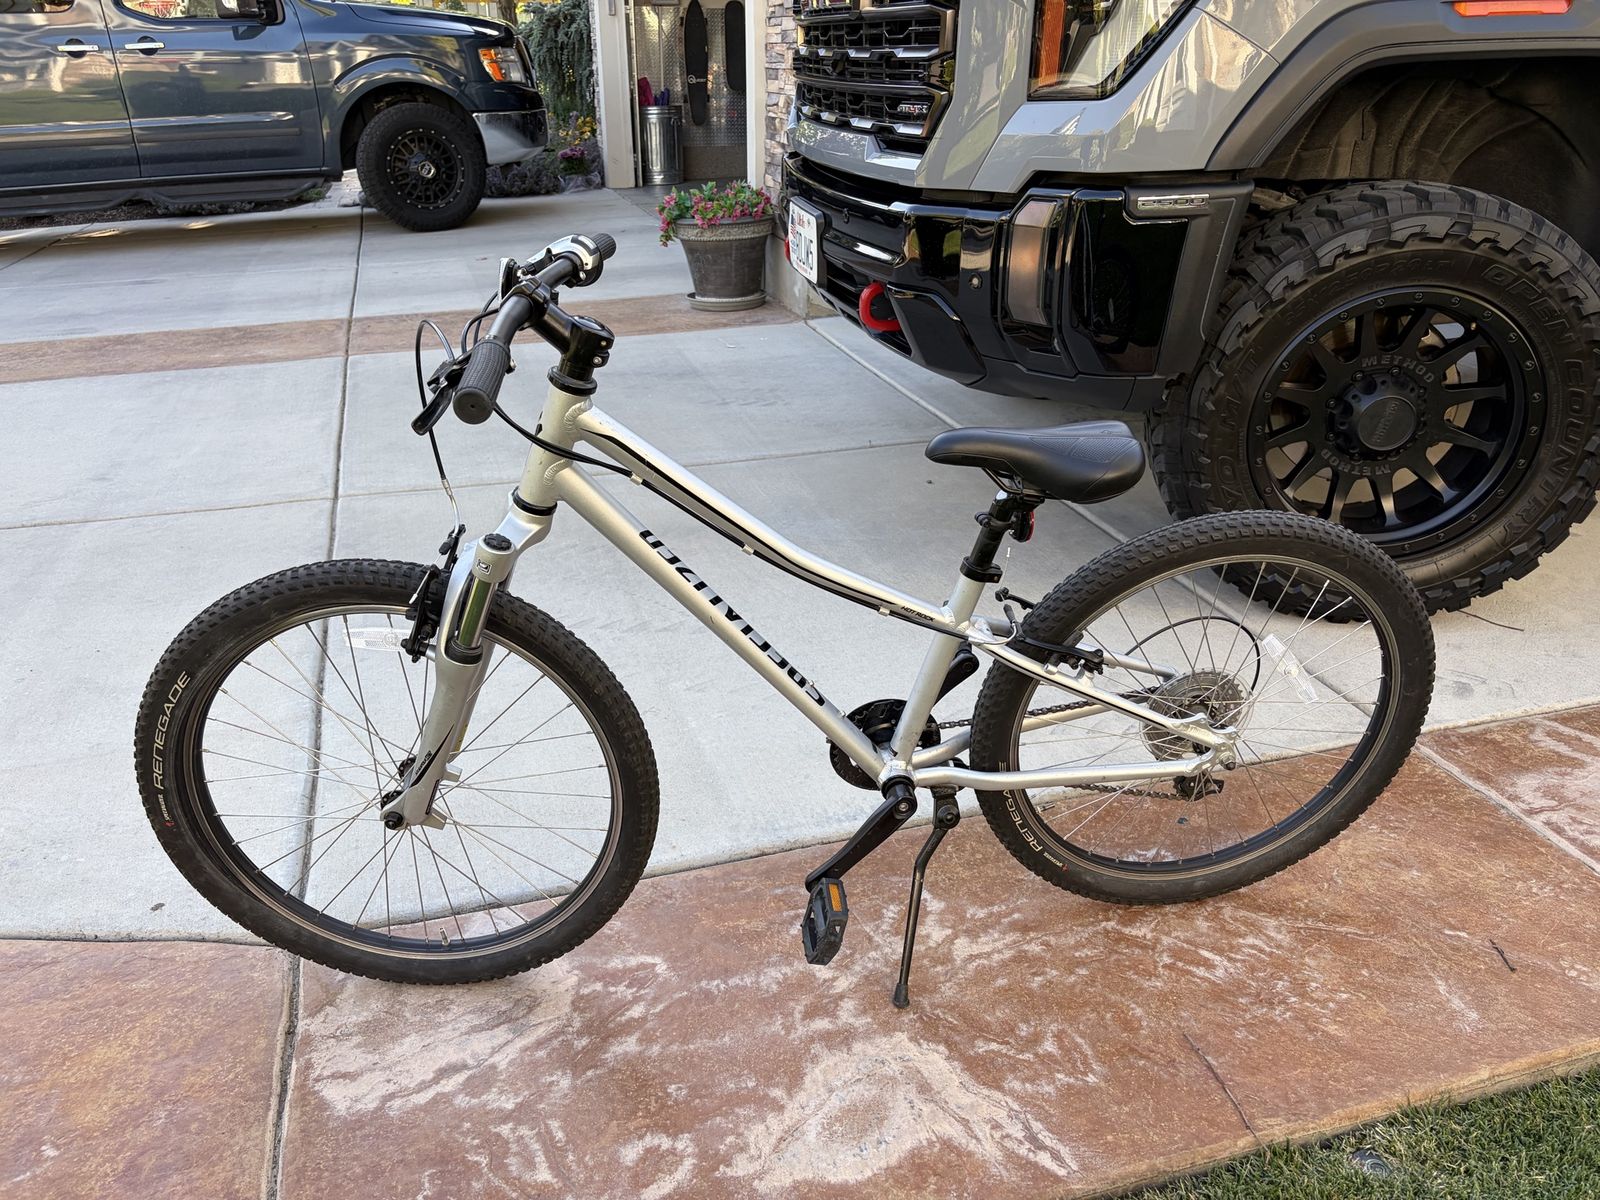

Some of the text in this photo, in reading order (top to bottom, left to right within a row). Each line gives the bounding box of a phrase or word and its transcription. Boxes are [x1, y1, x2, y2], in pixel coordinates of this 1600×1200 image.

[1139, 194, 1208, 209] 2500
[1361, 354, 1435, 383] METHOD
[1481, 263, 1587, 543] OPEN COUNTRY
[1321, 448, 1392, 476] METHOD
[152, 671, 191, 789] RENEGADE
